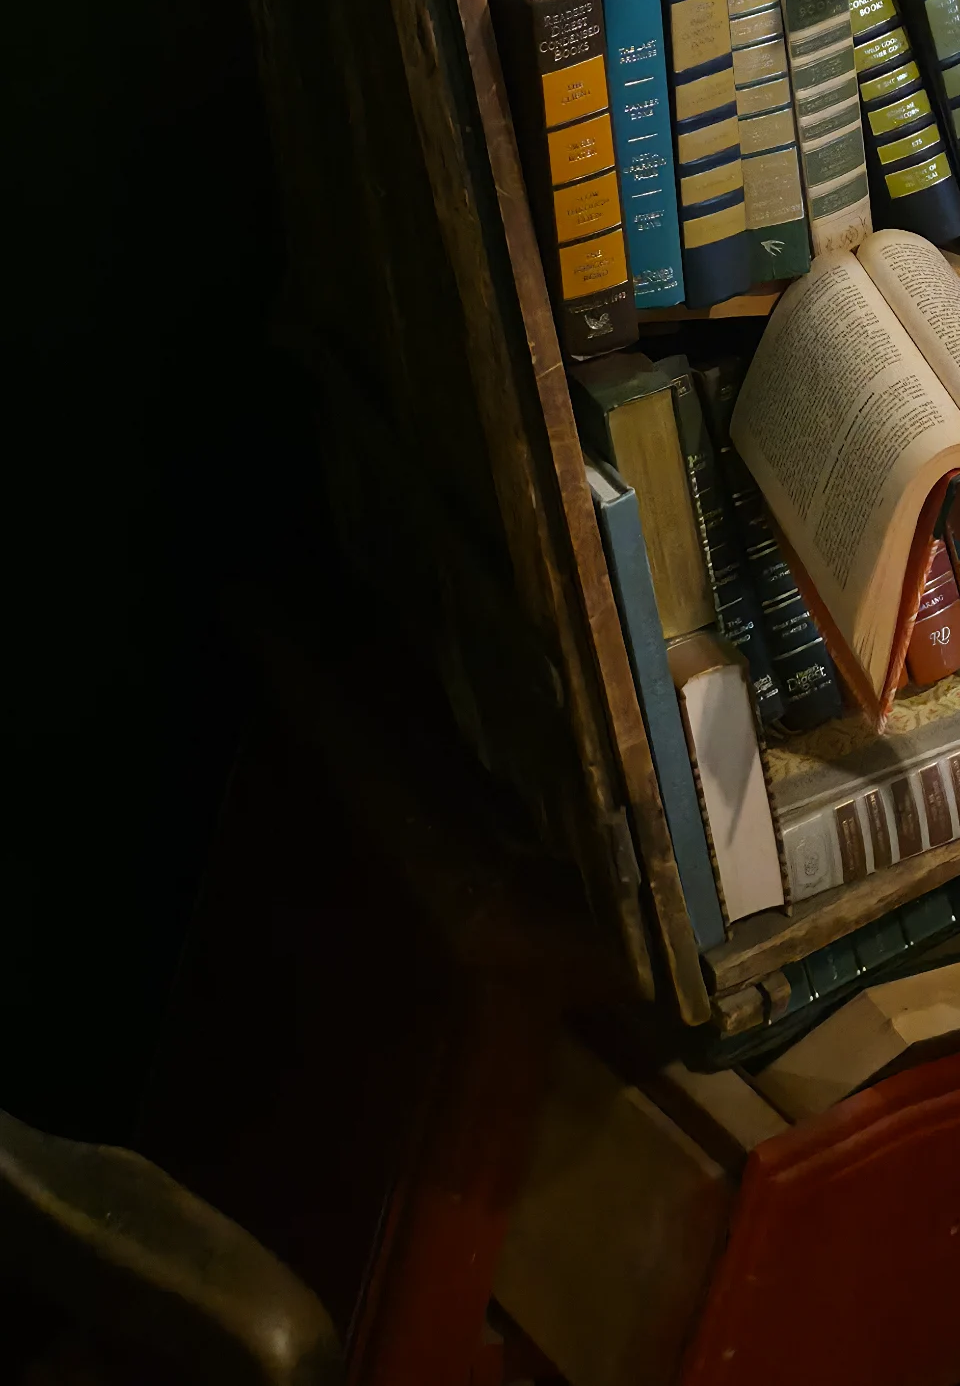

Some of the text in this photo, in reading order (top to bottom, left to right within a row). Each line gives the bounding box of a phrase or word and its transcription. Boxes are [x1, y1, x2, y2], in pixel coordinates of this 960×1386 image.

[539, 24, 600, 54] CONDENSED
[554, 41, 590, 61] BOOKS
[920, 595, 944, 610] ARANG
[930, 627, 950, 646] RD
